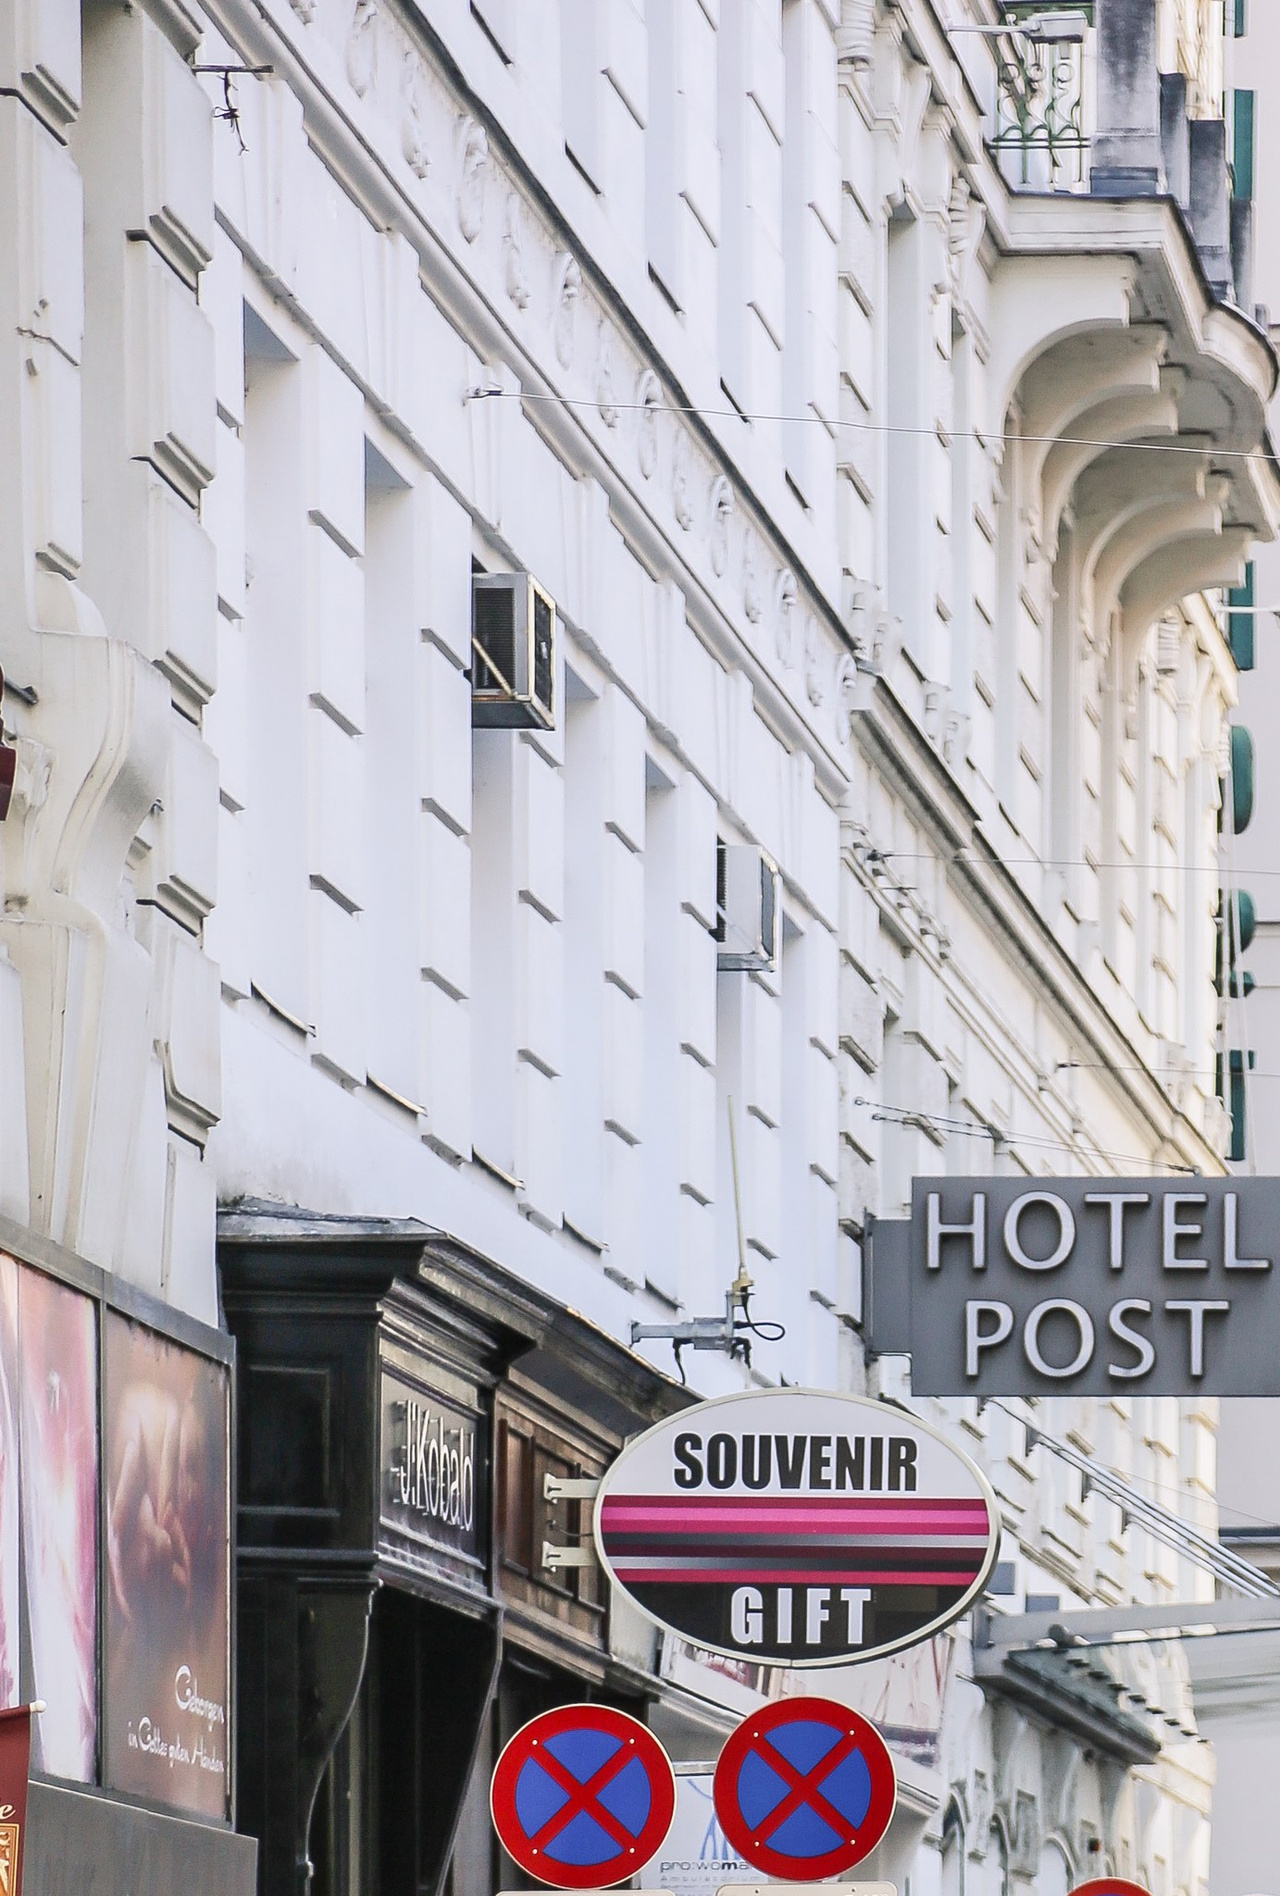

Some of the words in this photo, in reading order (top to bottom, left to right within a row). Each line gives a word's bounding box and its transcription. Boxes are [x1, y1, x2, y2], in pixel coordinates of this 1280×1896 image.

[926, 1191, 1273, 1273] HOTEL
[965, 1297, 1229, 1380] POST
[672, 1432, 919, 1493] SOUVENIR
[730, 1585, 874, 1645] GIFT
[138, 1716, 168, 1756] Gottes
[660, 1861, 756, 1873] pro:woma
